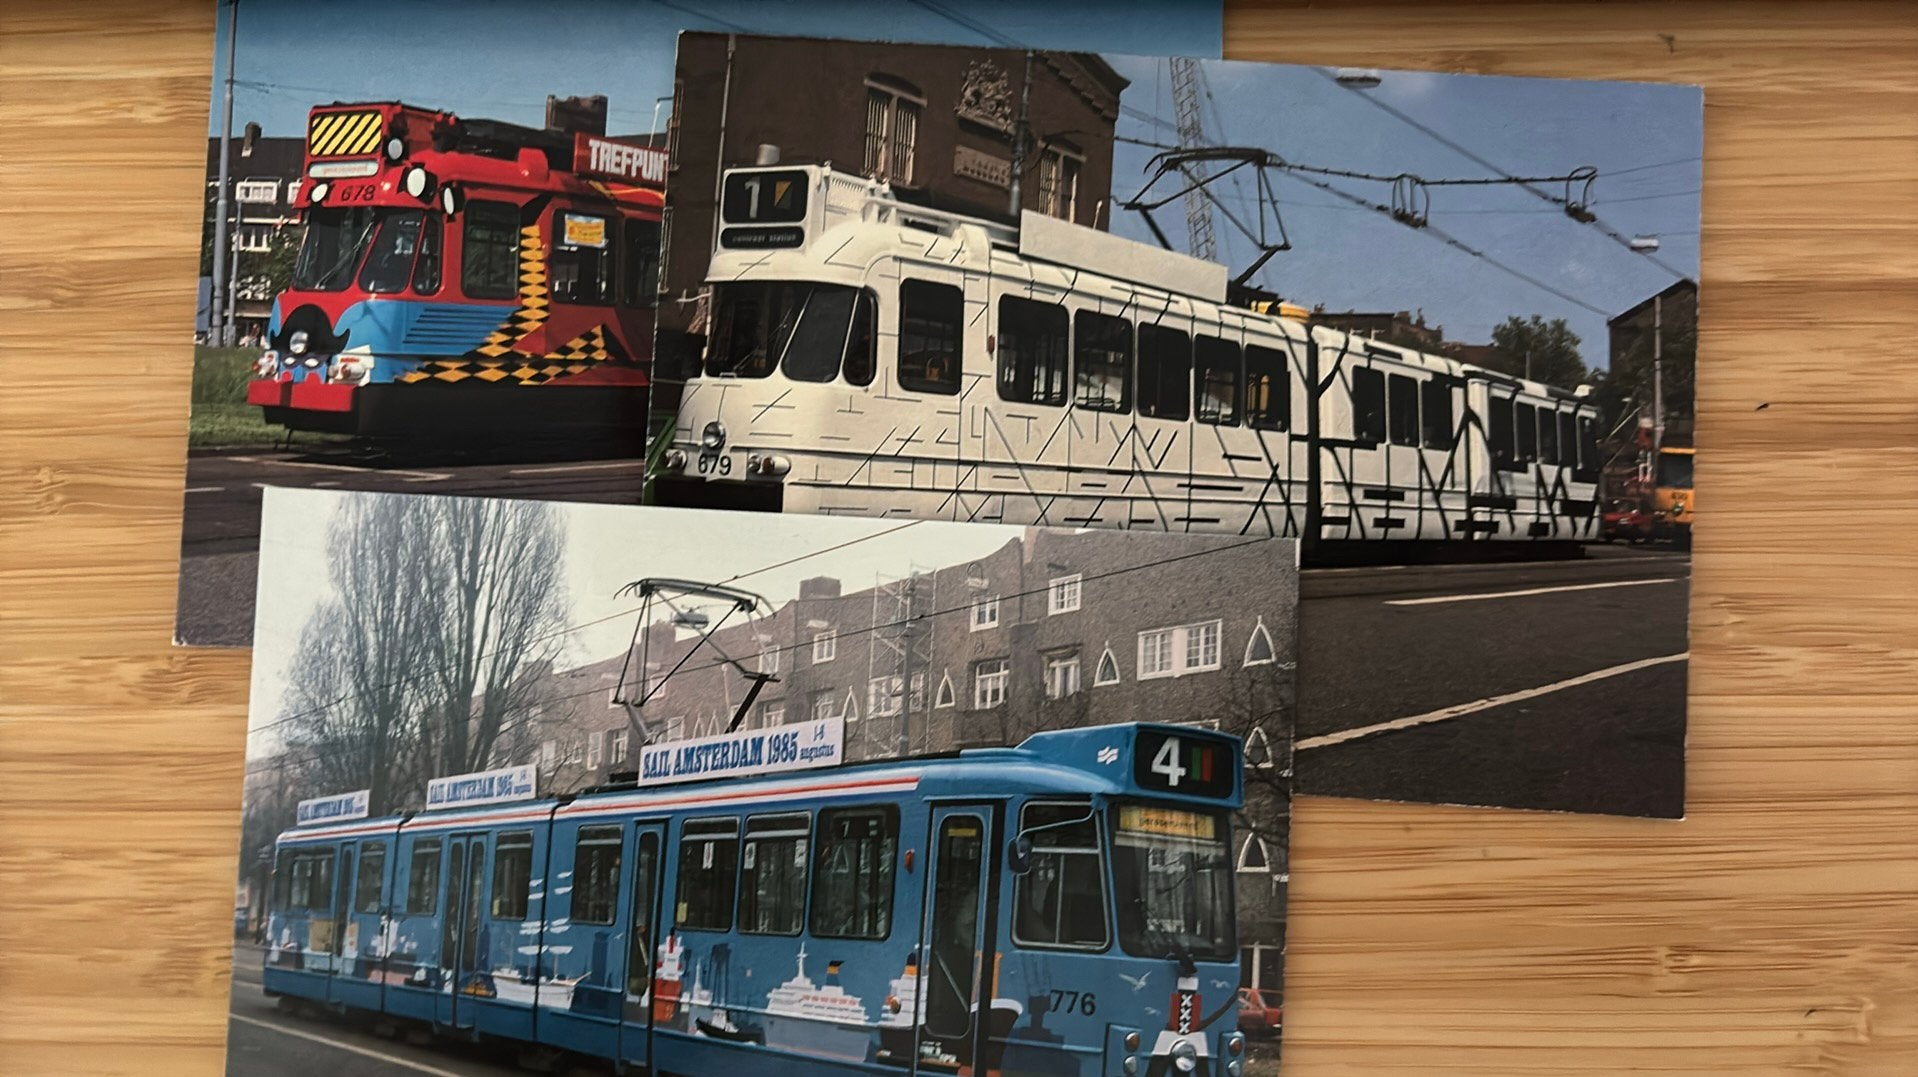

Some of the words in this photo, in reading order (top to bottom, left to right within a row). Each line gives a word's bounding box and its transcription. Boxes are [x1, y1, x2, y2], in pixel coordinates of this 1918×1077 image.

[341, 185, 376, 201] 678
[744, 177, 760, 218] 1
[698, 453, 731, 476] 679
[643, 750, 670, 778] SAIL
[673, 735, 765, 776] AMSTERDAM
[767, 731, 799, 764] 1985
[1151, 736, 1187, 787] 4
[1050, 989, 1096, 1017] 776
